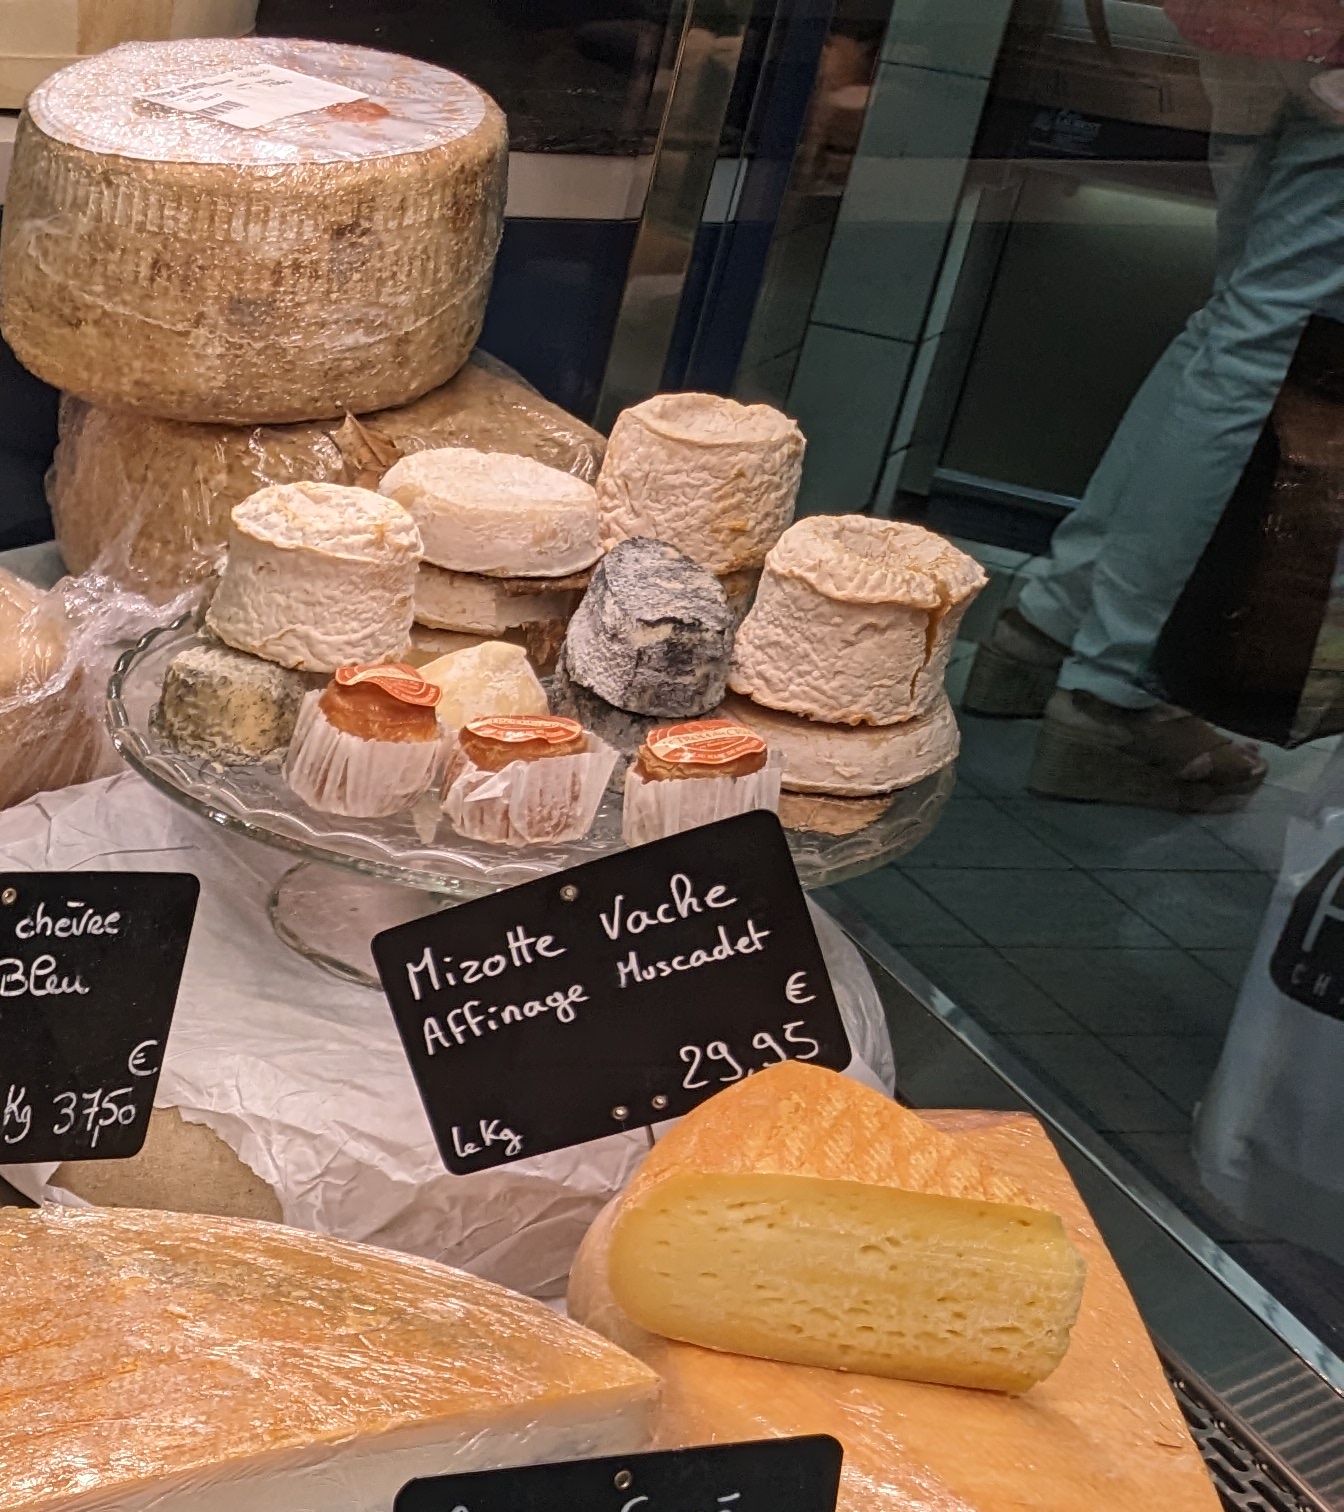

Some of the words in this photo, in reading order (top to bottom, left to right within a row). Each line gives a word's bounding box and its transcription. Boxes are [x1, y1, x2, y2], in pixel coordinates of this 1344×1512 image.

[406, 925, 567, 1001] Mizotte
[600, 873, 738, 942] Vache
[616, 918, 771, 988] Muscadet
[785, 970, 816, 1005] €
[127, 1039, 159, 1077] €
[3, 1083, 33, 1144] Kg
[53, 1086, 137, 1148] 37,50
